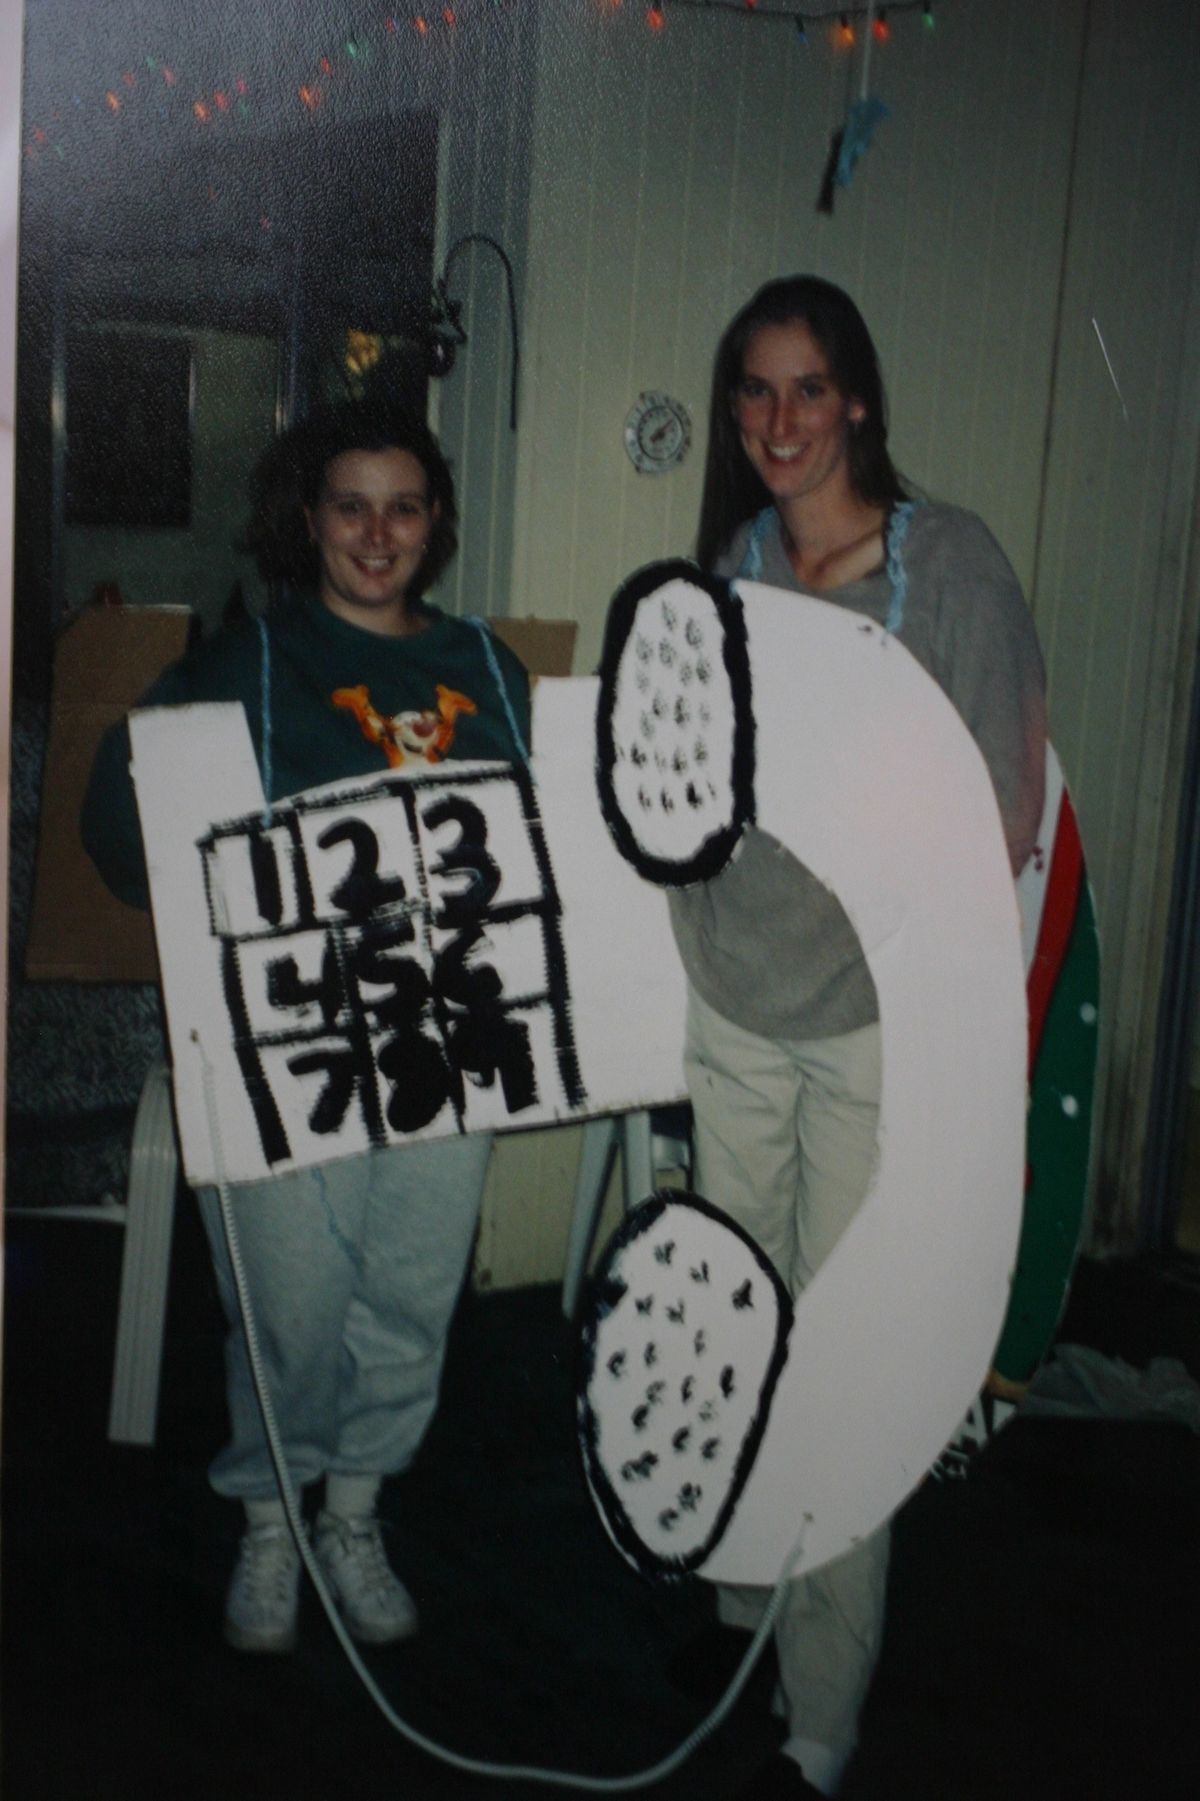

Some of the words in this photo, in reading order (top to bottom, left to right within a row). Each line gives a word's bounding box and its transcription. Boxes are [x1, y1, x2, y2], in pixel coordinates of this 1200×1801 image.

[249, 826, 283, 926] 1
[316, 816, 406, 914] 2
[420, 794, 502, 928] 3
[266, 930, 343, 1032] 4
[356, 920, 434, 1022] 5
[433, 922, 503, 1006] 6
[287, 1049, 354, 1135] 7
[378, 1024, 453, 1133] 8
[451, 1010, 538, 1114] 9
